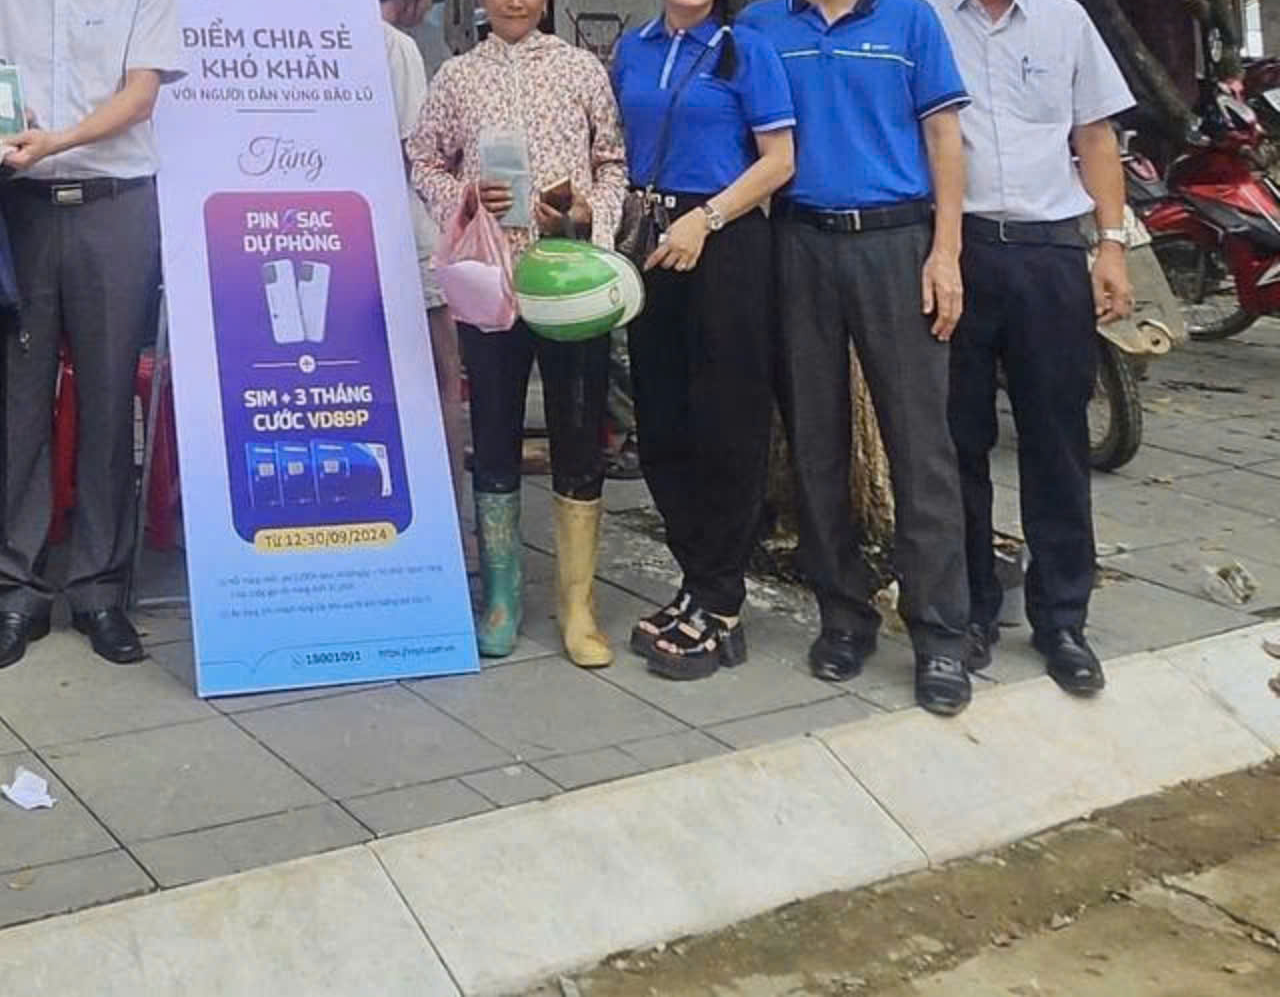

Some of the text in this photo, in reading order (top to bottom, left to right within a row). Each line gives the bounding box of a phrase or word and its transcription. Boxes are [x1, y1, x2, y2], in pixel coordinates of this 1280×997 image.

[183, 18, 353, 50] ĐIỂM CHIA SẺ
[202, 53, 340, 80] KHÓ KHĂN
[172, 87, 197, 101] VỚI
[248, 86, 278, 102] DÂN
[281, 86, 320, 102] VÙNG
[238, 136, 323, 183] Tặng
[246, 210, 333, 232] PIN SẠC
[243, 230, 342, 256] DỰ PHÒNG
[244, 389, 277, 408] SIM
[295, 388, 307, 406] 3
[309, 383, 373, 405] THÁNG
[253, 408, 369, 431] CƯỚC VD89P
[286, 528, 387, 546] 12-30/09/2024
